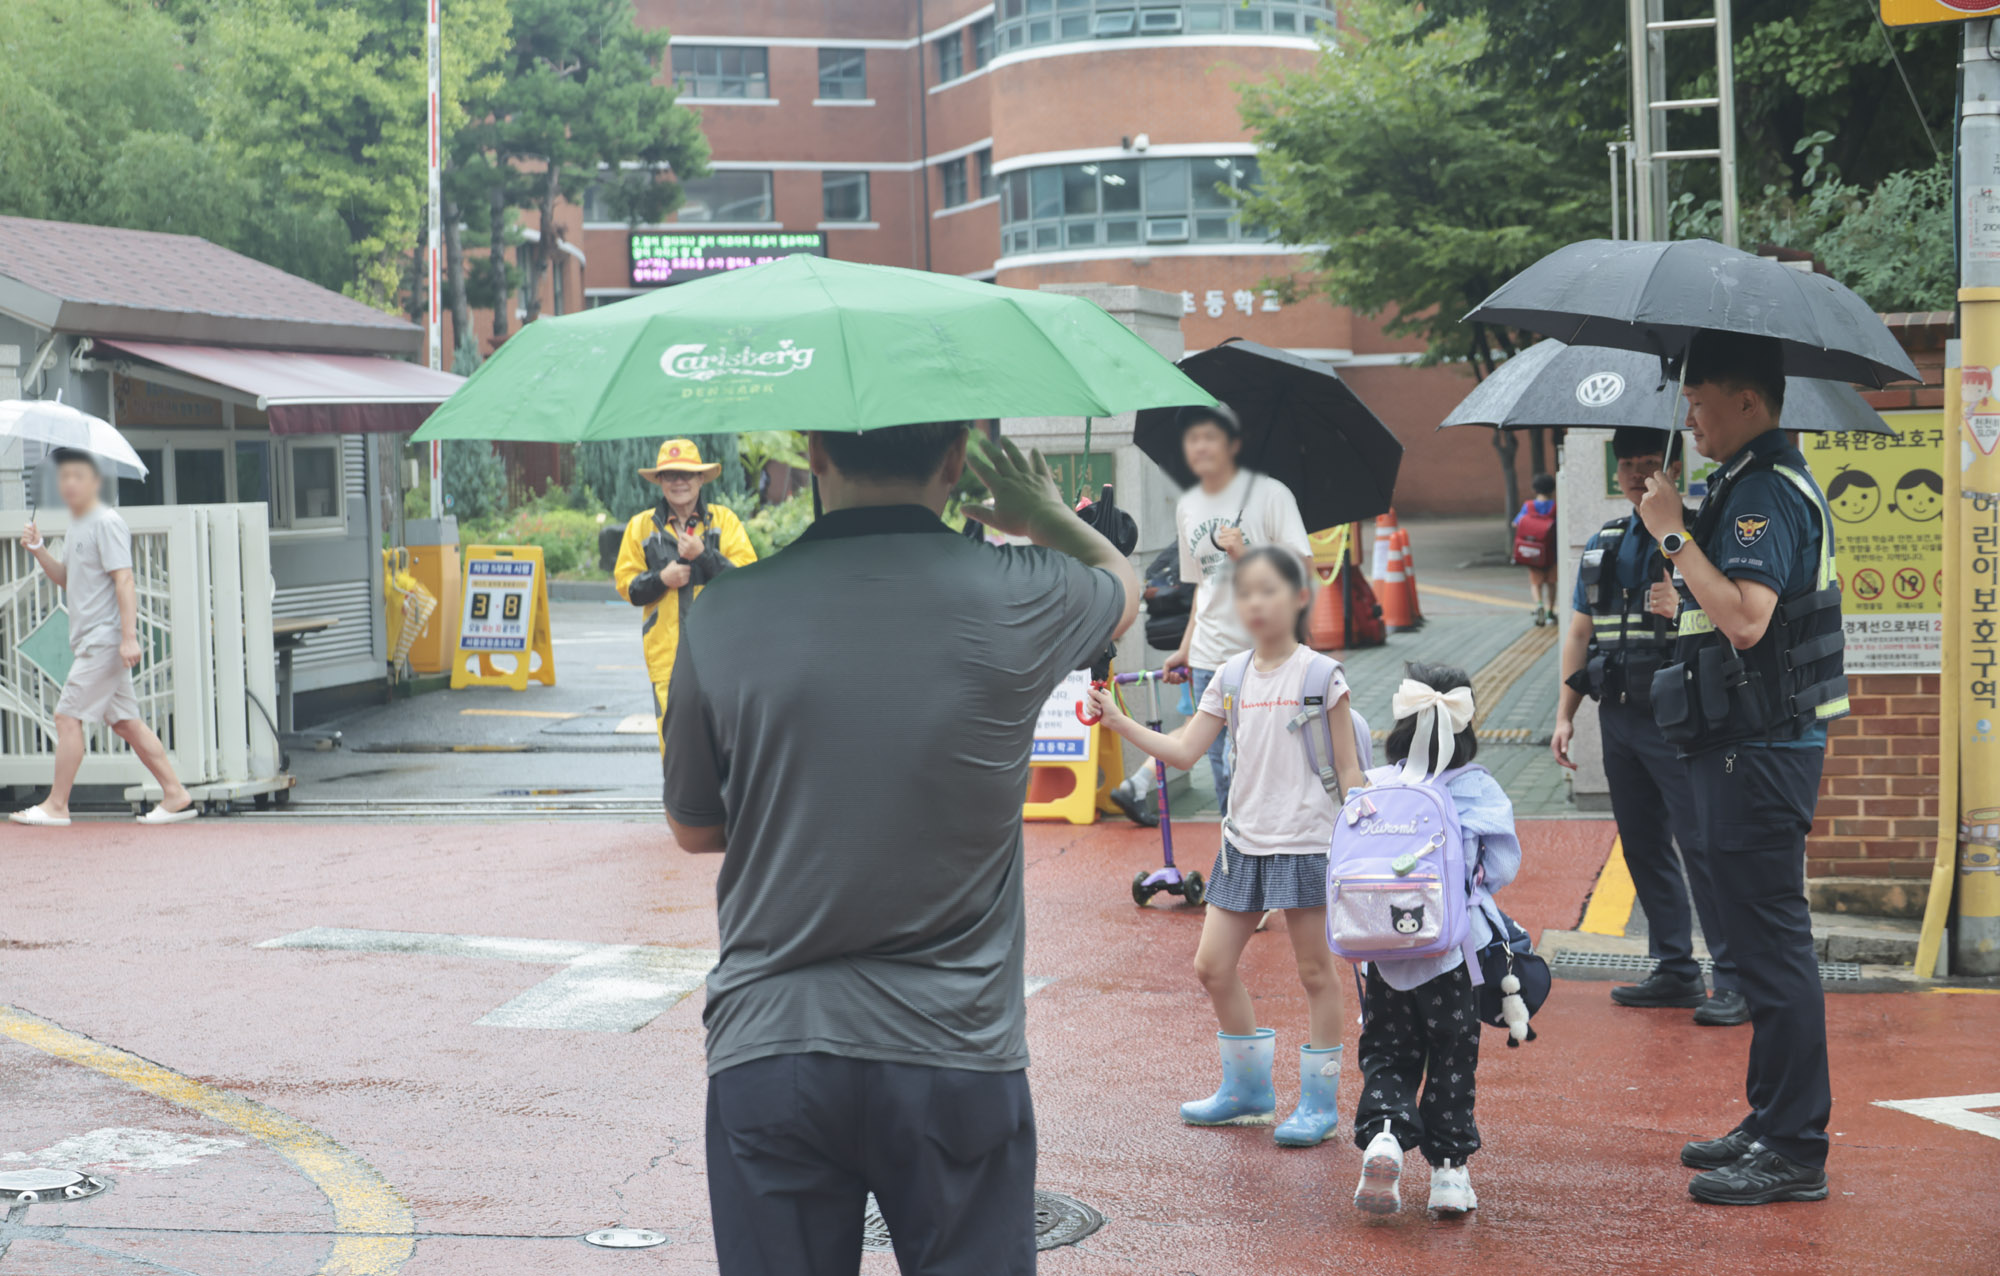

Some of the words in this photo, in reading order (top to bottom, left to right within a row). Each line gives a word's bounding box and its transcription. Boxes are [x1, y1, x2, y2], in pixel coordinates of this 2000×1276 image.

[660, 340, 816, 381] Carlsberg
[681, 382, 775, 398] DENMARK
[474, 594, 487, 616] 3
[505, 595, 518, 617] 8
[1845, 620, 1929, 634] 경계선으로부터
[1359, 817, 1419, 836] Kuromi
